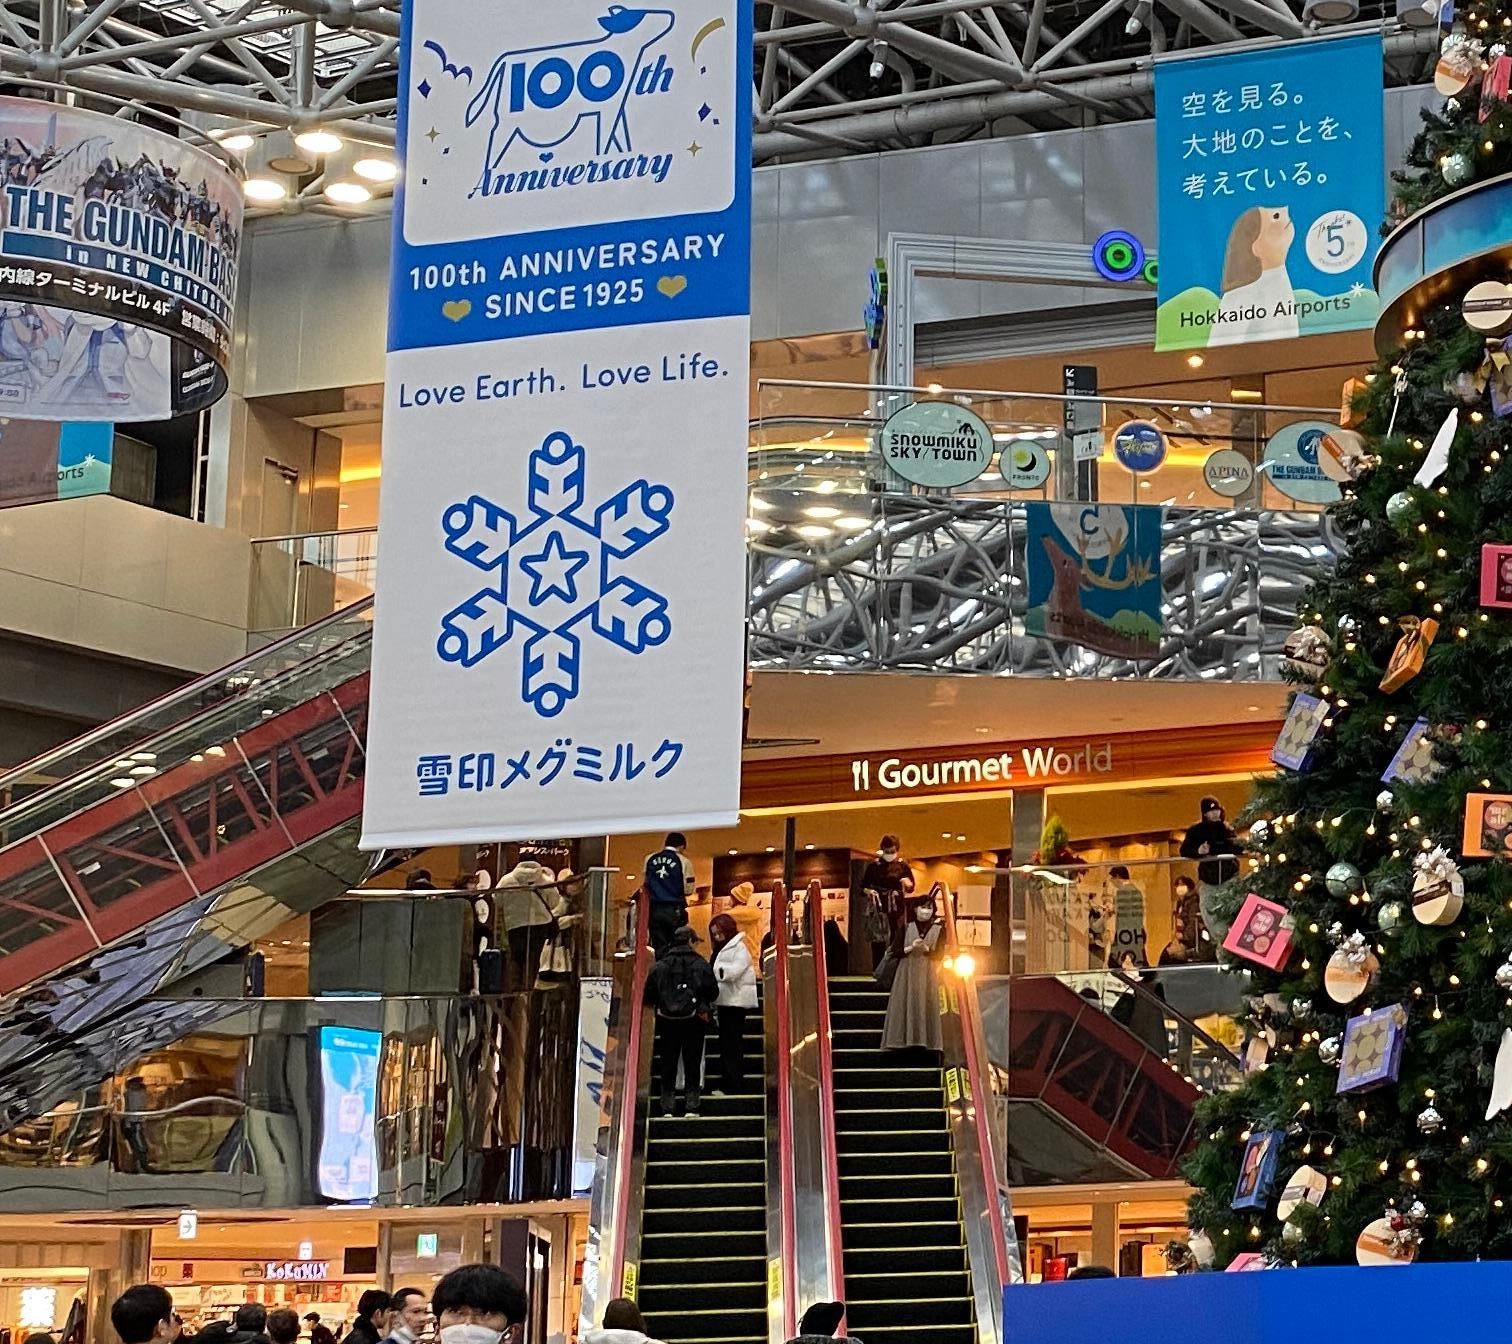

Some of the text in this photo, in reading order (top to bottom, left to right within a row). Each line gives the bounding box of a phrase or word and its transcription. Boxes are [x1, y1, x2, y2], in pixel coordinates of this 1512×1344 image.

[509, 50, 675, 113] 100th
[1182, 81, 1303, 118] 空を見る。
[1182, 116, 1352, 159] 大地のことを、
[468, 150, 673, 200] Anniversary
[1182, 162, 1327, 199] 考えている。
[6, 187, 74, 236] THE
[83, 200, 205, 278] GUNDAM
[1327, 224, 1345, 257] 5
[106, 253, 151, 280] NEW
[160, 271, 221, 314] CHITOSE
[410, 233, 726, 291] 100th ANNIVERSARY
[485, 277, 645, 319] SINCE 1925
[1180, 294, 1351, 328] Hokkaido Airports
[399, 353, 730, 409] Love Earth. Love Life.
[890, 447, 978, 462] SKY TOWN
[416, 738, 685, 797] 雪印メグミルク
[878, 742, 1113, 789] Gourmet World
